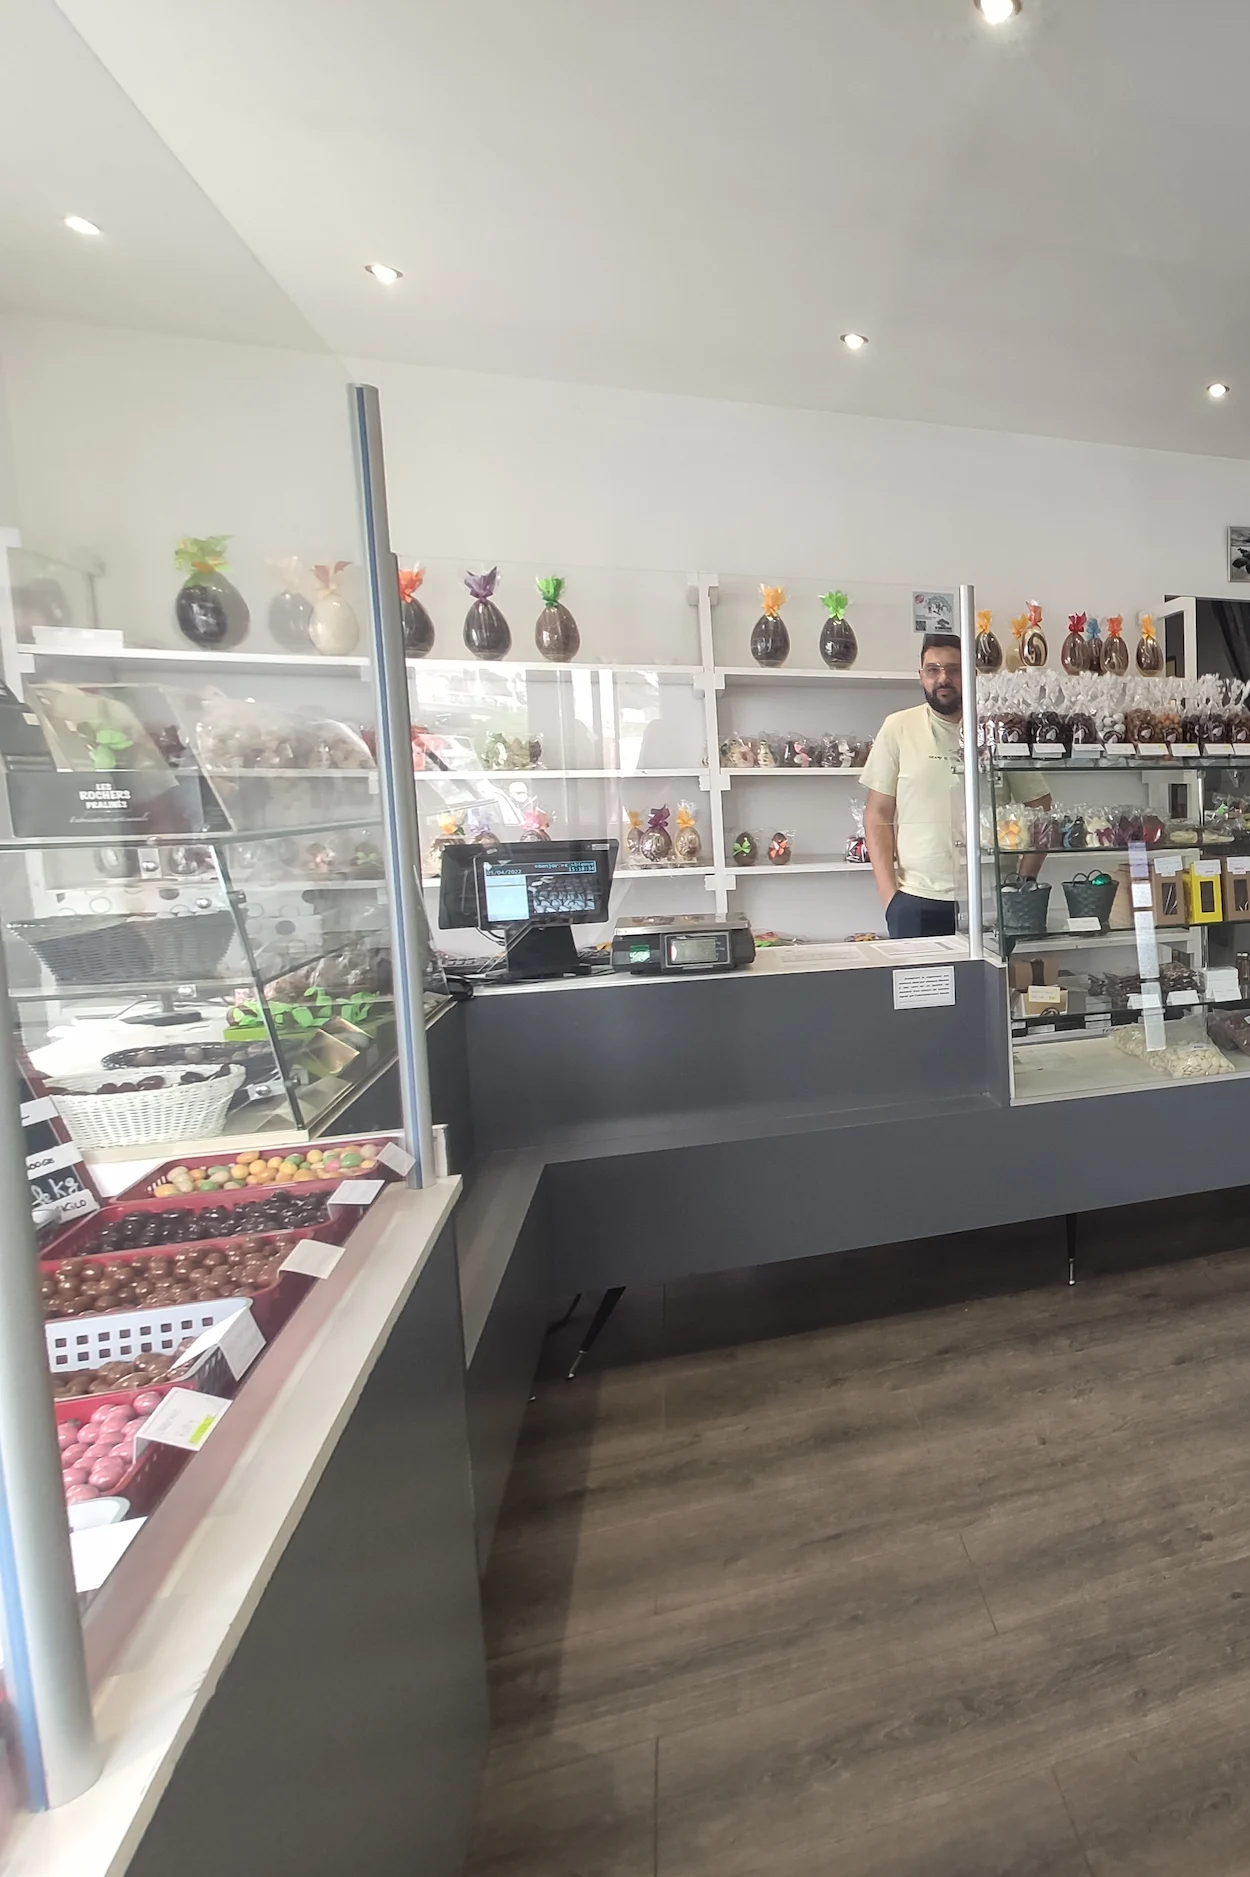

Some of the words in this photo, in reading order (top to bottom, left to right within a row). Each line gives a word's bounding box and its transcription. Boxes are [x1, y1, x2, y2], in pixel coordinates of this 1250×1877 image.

[95, 783, 112, 791] LES
[79, 790, 131, 800] ROCHERS
[48, 1177, 79, 1199] kg
